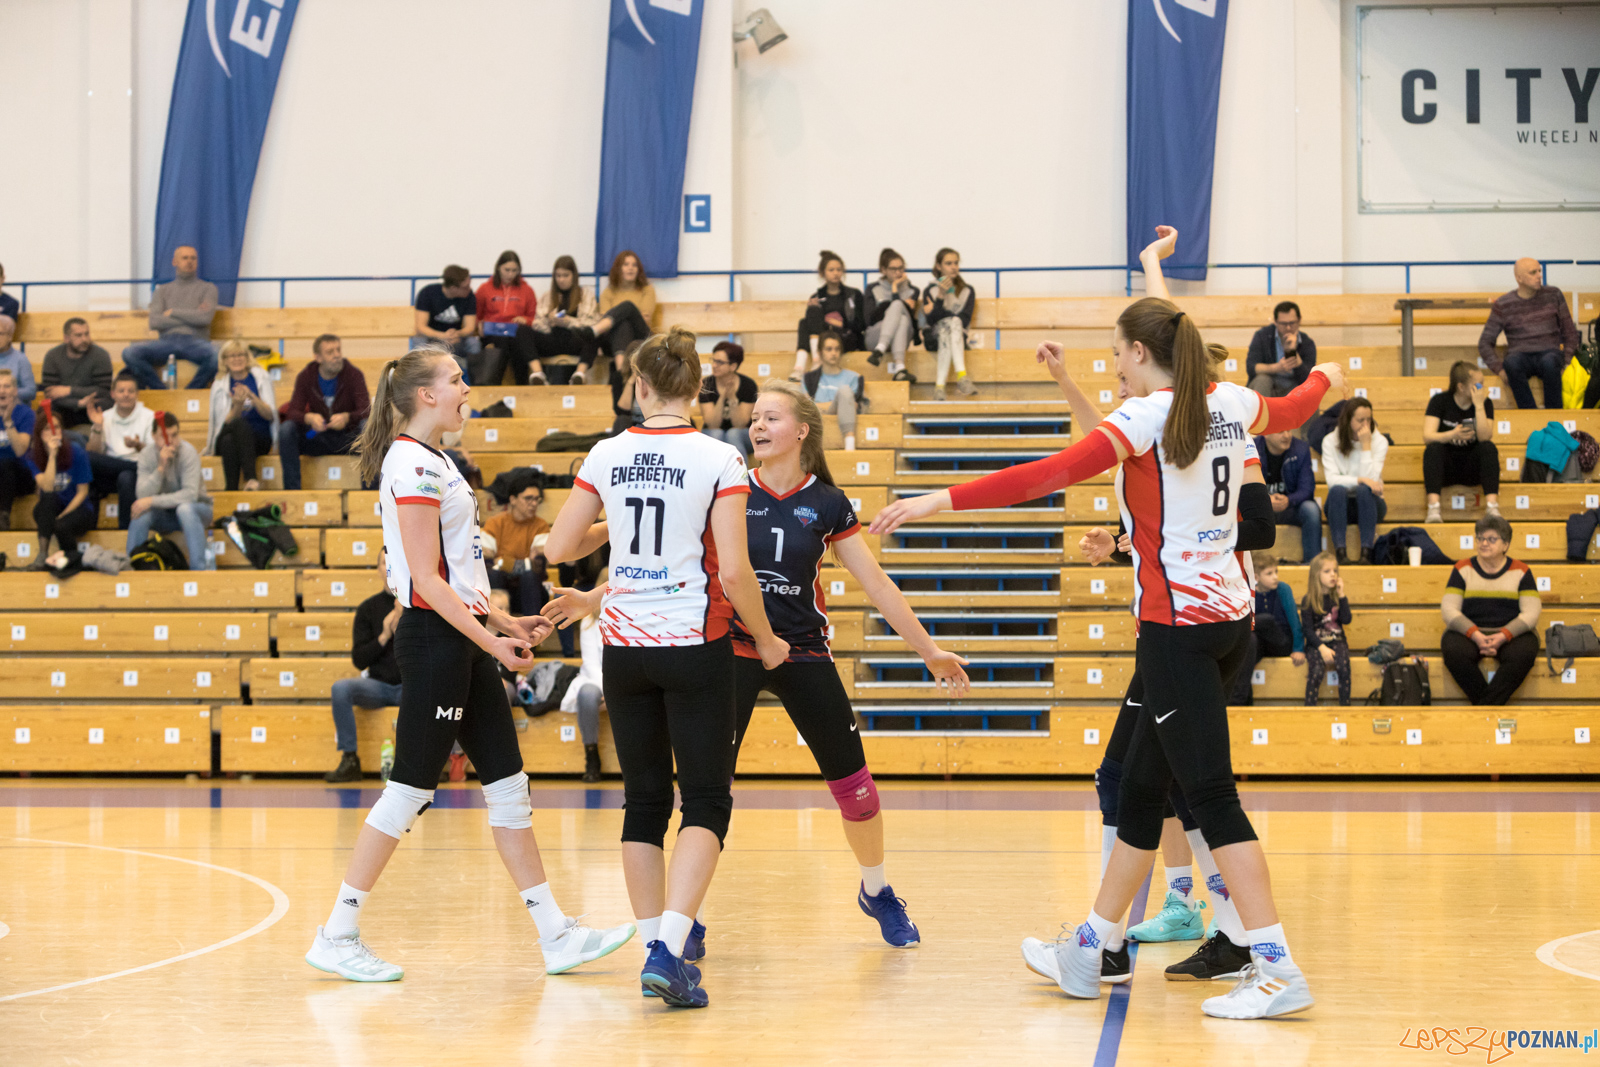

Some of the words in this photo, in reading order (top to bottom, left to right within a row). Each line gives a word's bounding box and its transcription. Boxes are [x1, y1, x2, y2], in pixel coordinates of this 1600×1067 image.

[1517, 130, 1578, 147] WIĘCEJ
[689, 199, 707, 228] C
[634, 453, 665, 466] ENEA
[611, 466, 686, 489] ENERGETYK
[1212, 456, 1230, 516] 8
[771, 527, 785, 562] 1
